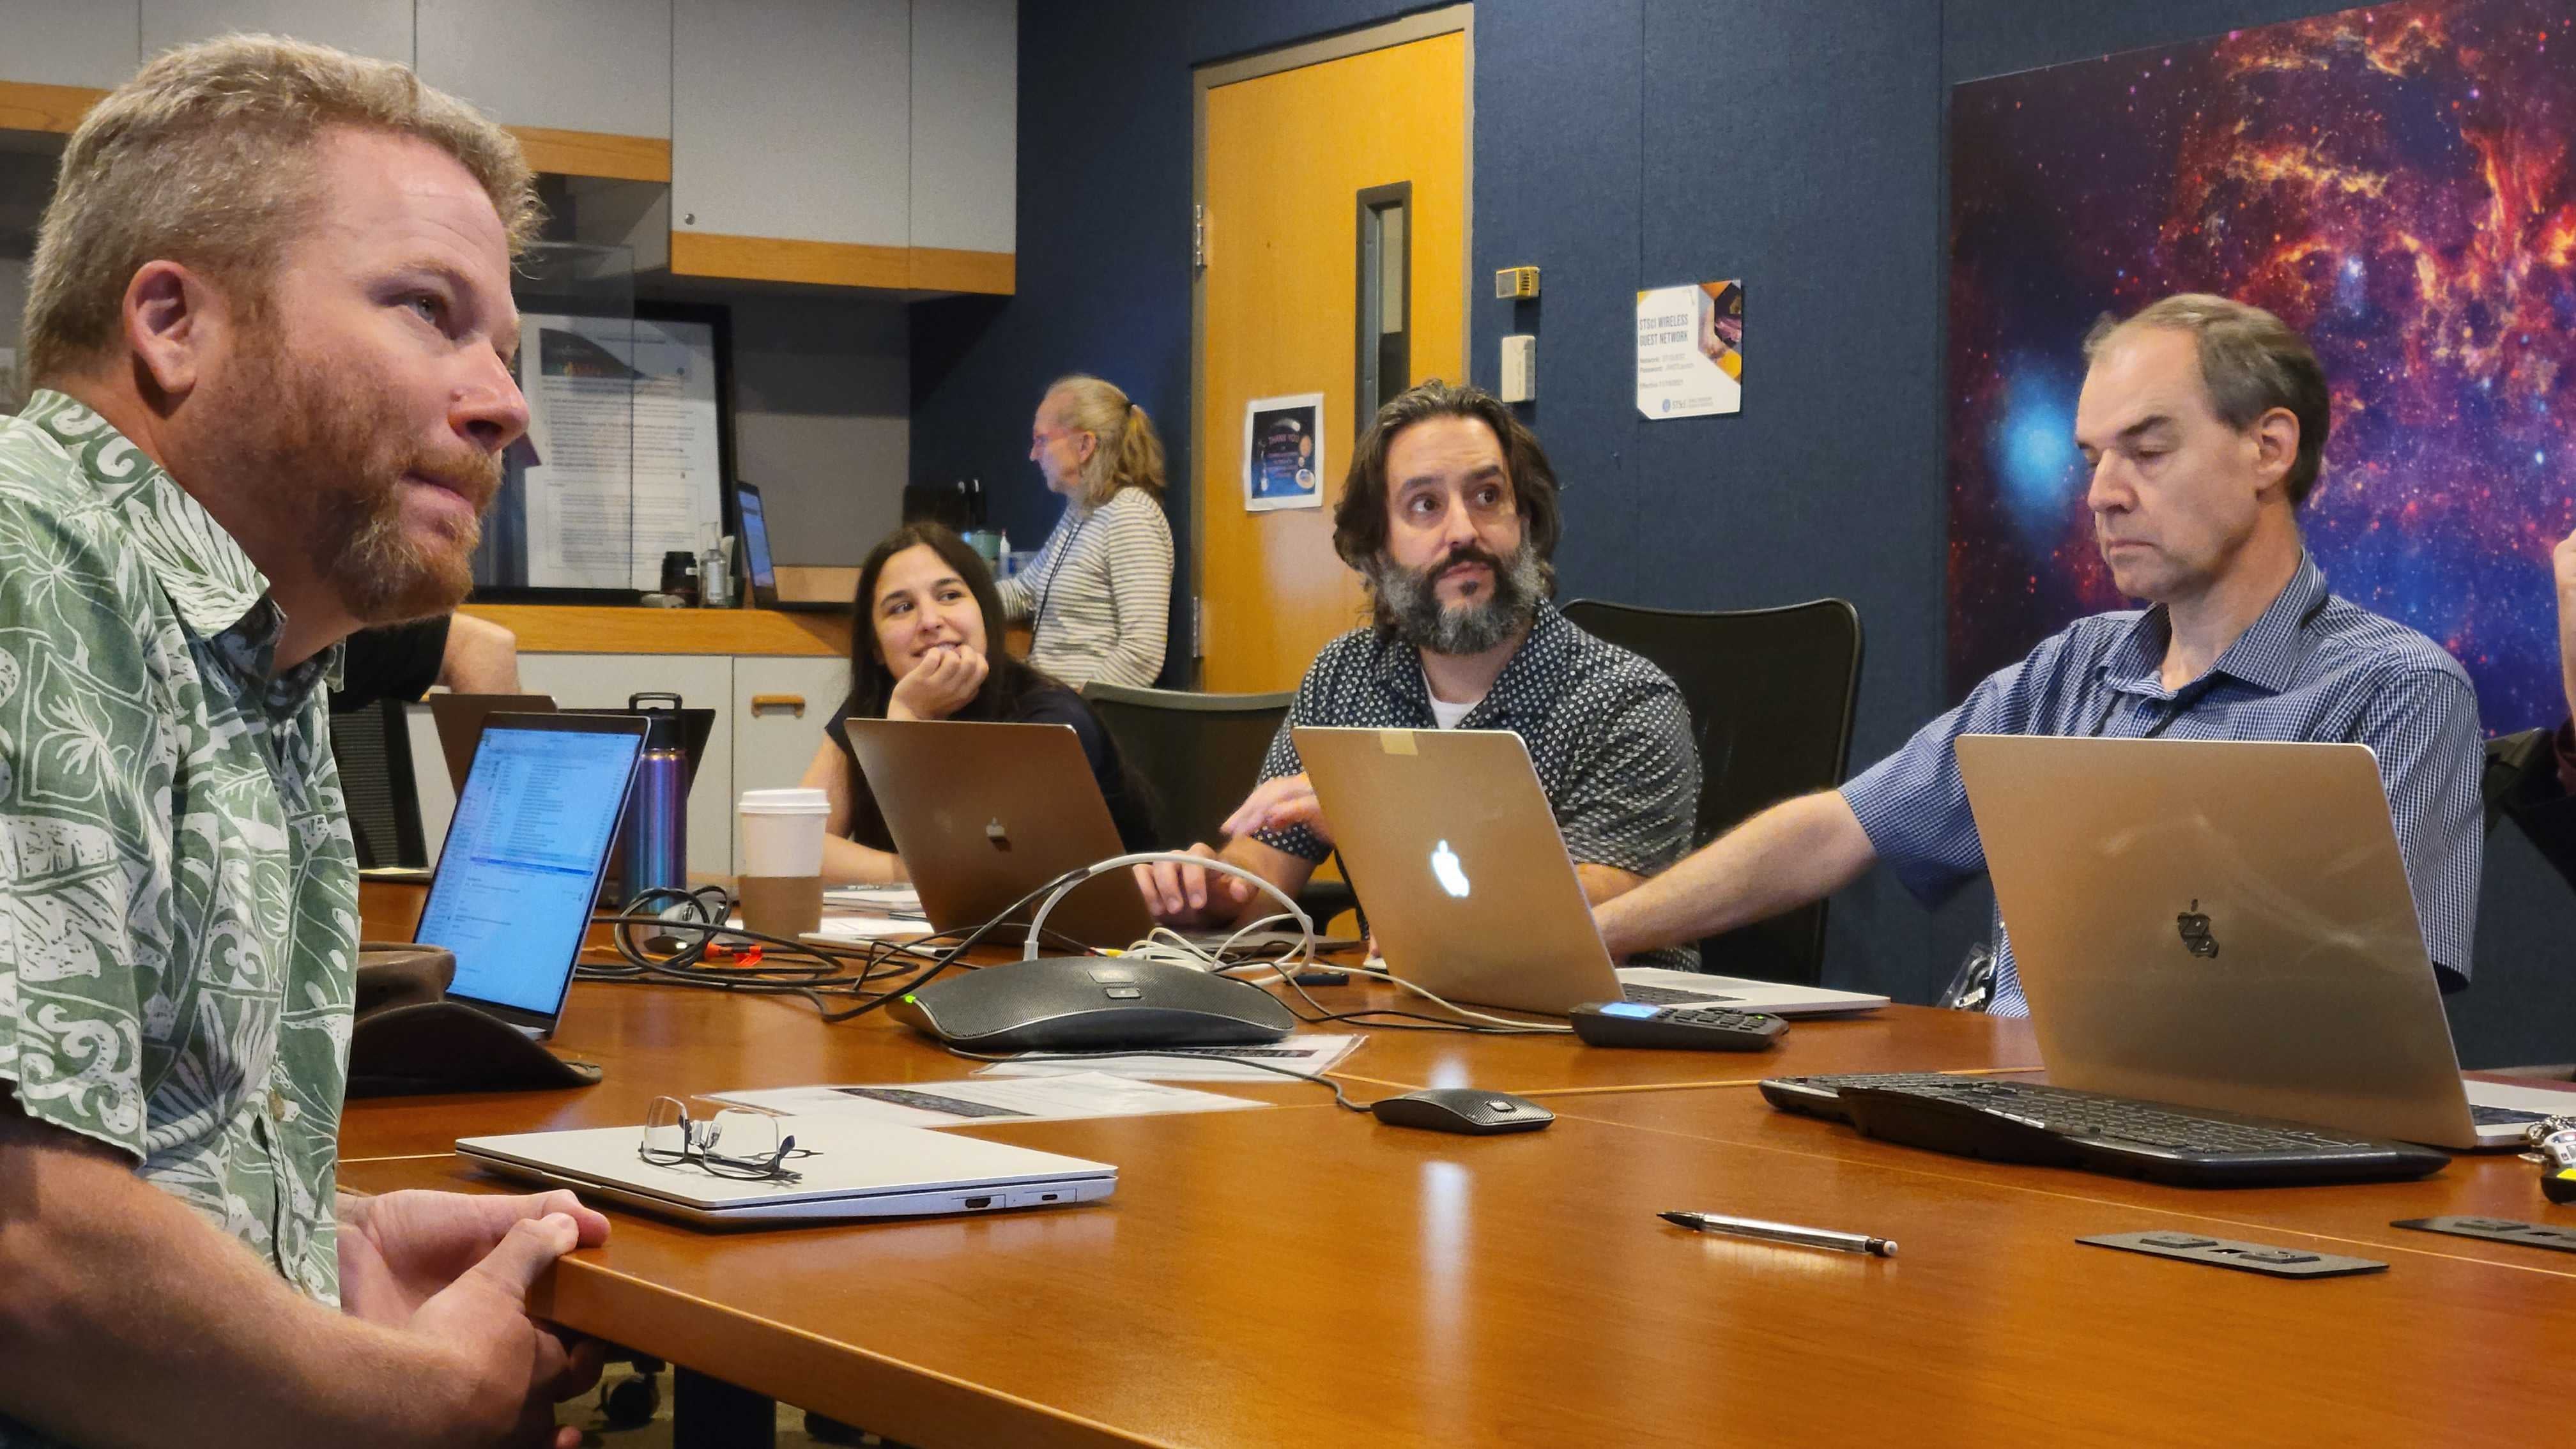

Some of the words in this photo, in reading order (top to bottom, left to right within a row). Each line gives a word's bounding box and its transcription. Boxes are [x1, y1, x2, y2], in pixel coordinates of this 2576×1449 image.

[1658, 314, 1689, 328] WIRELESS
[1639, 334, 1657, 347] GUEST
[1659, 331, 1688, 344] NETWORK
[1268, 434, 1287, 445] THANK
[1287, 433, 1300, 443] YOU
